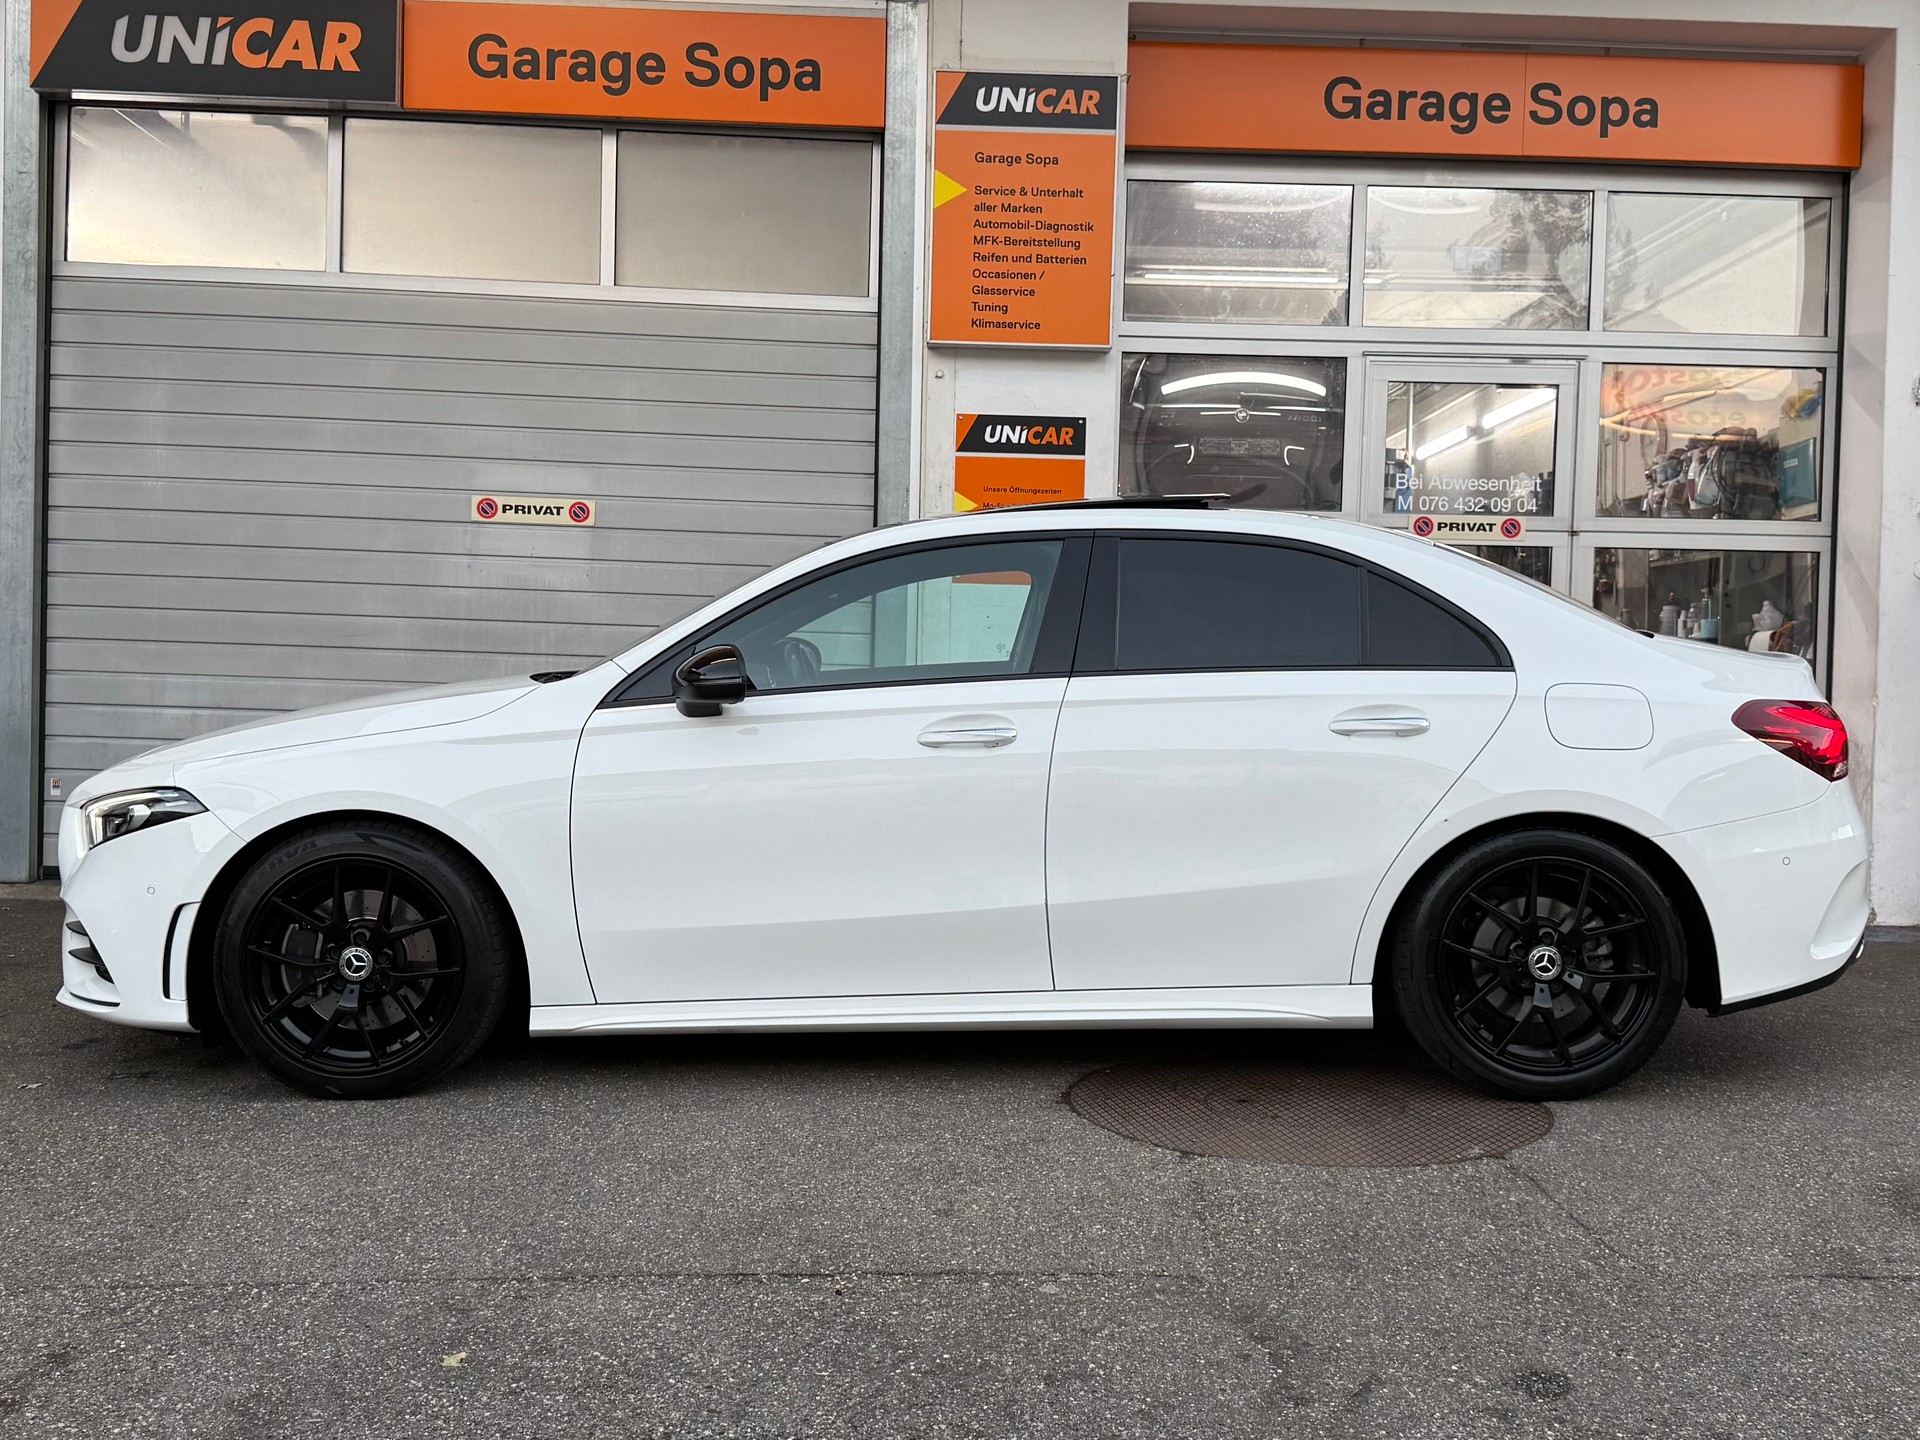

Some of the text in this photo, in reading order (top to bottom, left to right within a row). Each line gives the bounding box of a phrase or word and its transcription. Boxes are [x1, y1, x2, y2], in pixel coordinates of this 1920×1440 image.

[468, 34, 820, 101] Garage Sopa
[1324, 76, 1658, 138] Garage Sopa
[975, 152, 1058, 167] Garage Sopa
[975, 186, 1083, 197] Service & Unterhalt
[974, 203, 1042, 213] aller Marken
[974, 219, 1093, 233] Automobil-Diagnostik
[974, 236, 1080, 250] MFK-Bereitstellung
[973, 252, 1086, 264] Reifen und Batterien
[973, 269, 1045, 279] Occasionen /
[972, 285, 1035, 296] Glasservice
[972, 302, 1008, 314] Tuning
[972, 318, 1040, 329] Klimaservice
[1395, 474, 1542, 492] Bei Abwesenheit
[1009, 485, 1062, 495] Öffnungszeiten
[502, 504, 564, 515] PRIVAT
[1398, 496, 1538, 513] M 076 432 09 04
[1438, 522, 1496, 532] PRIVAT
